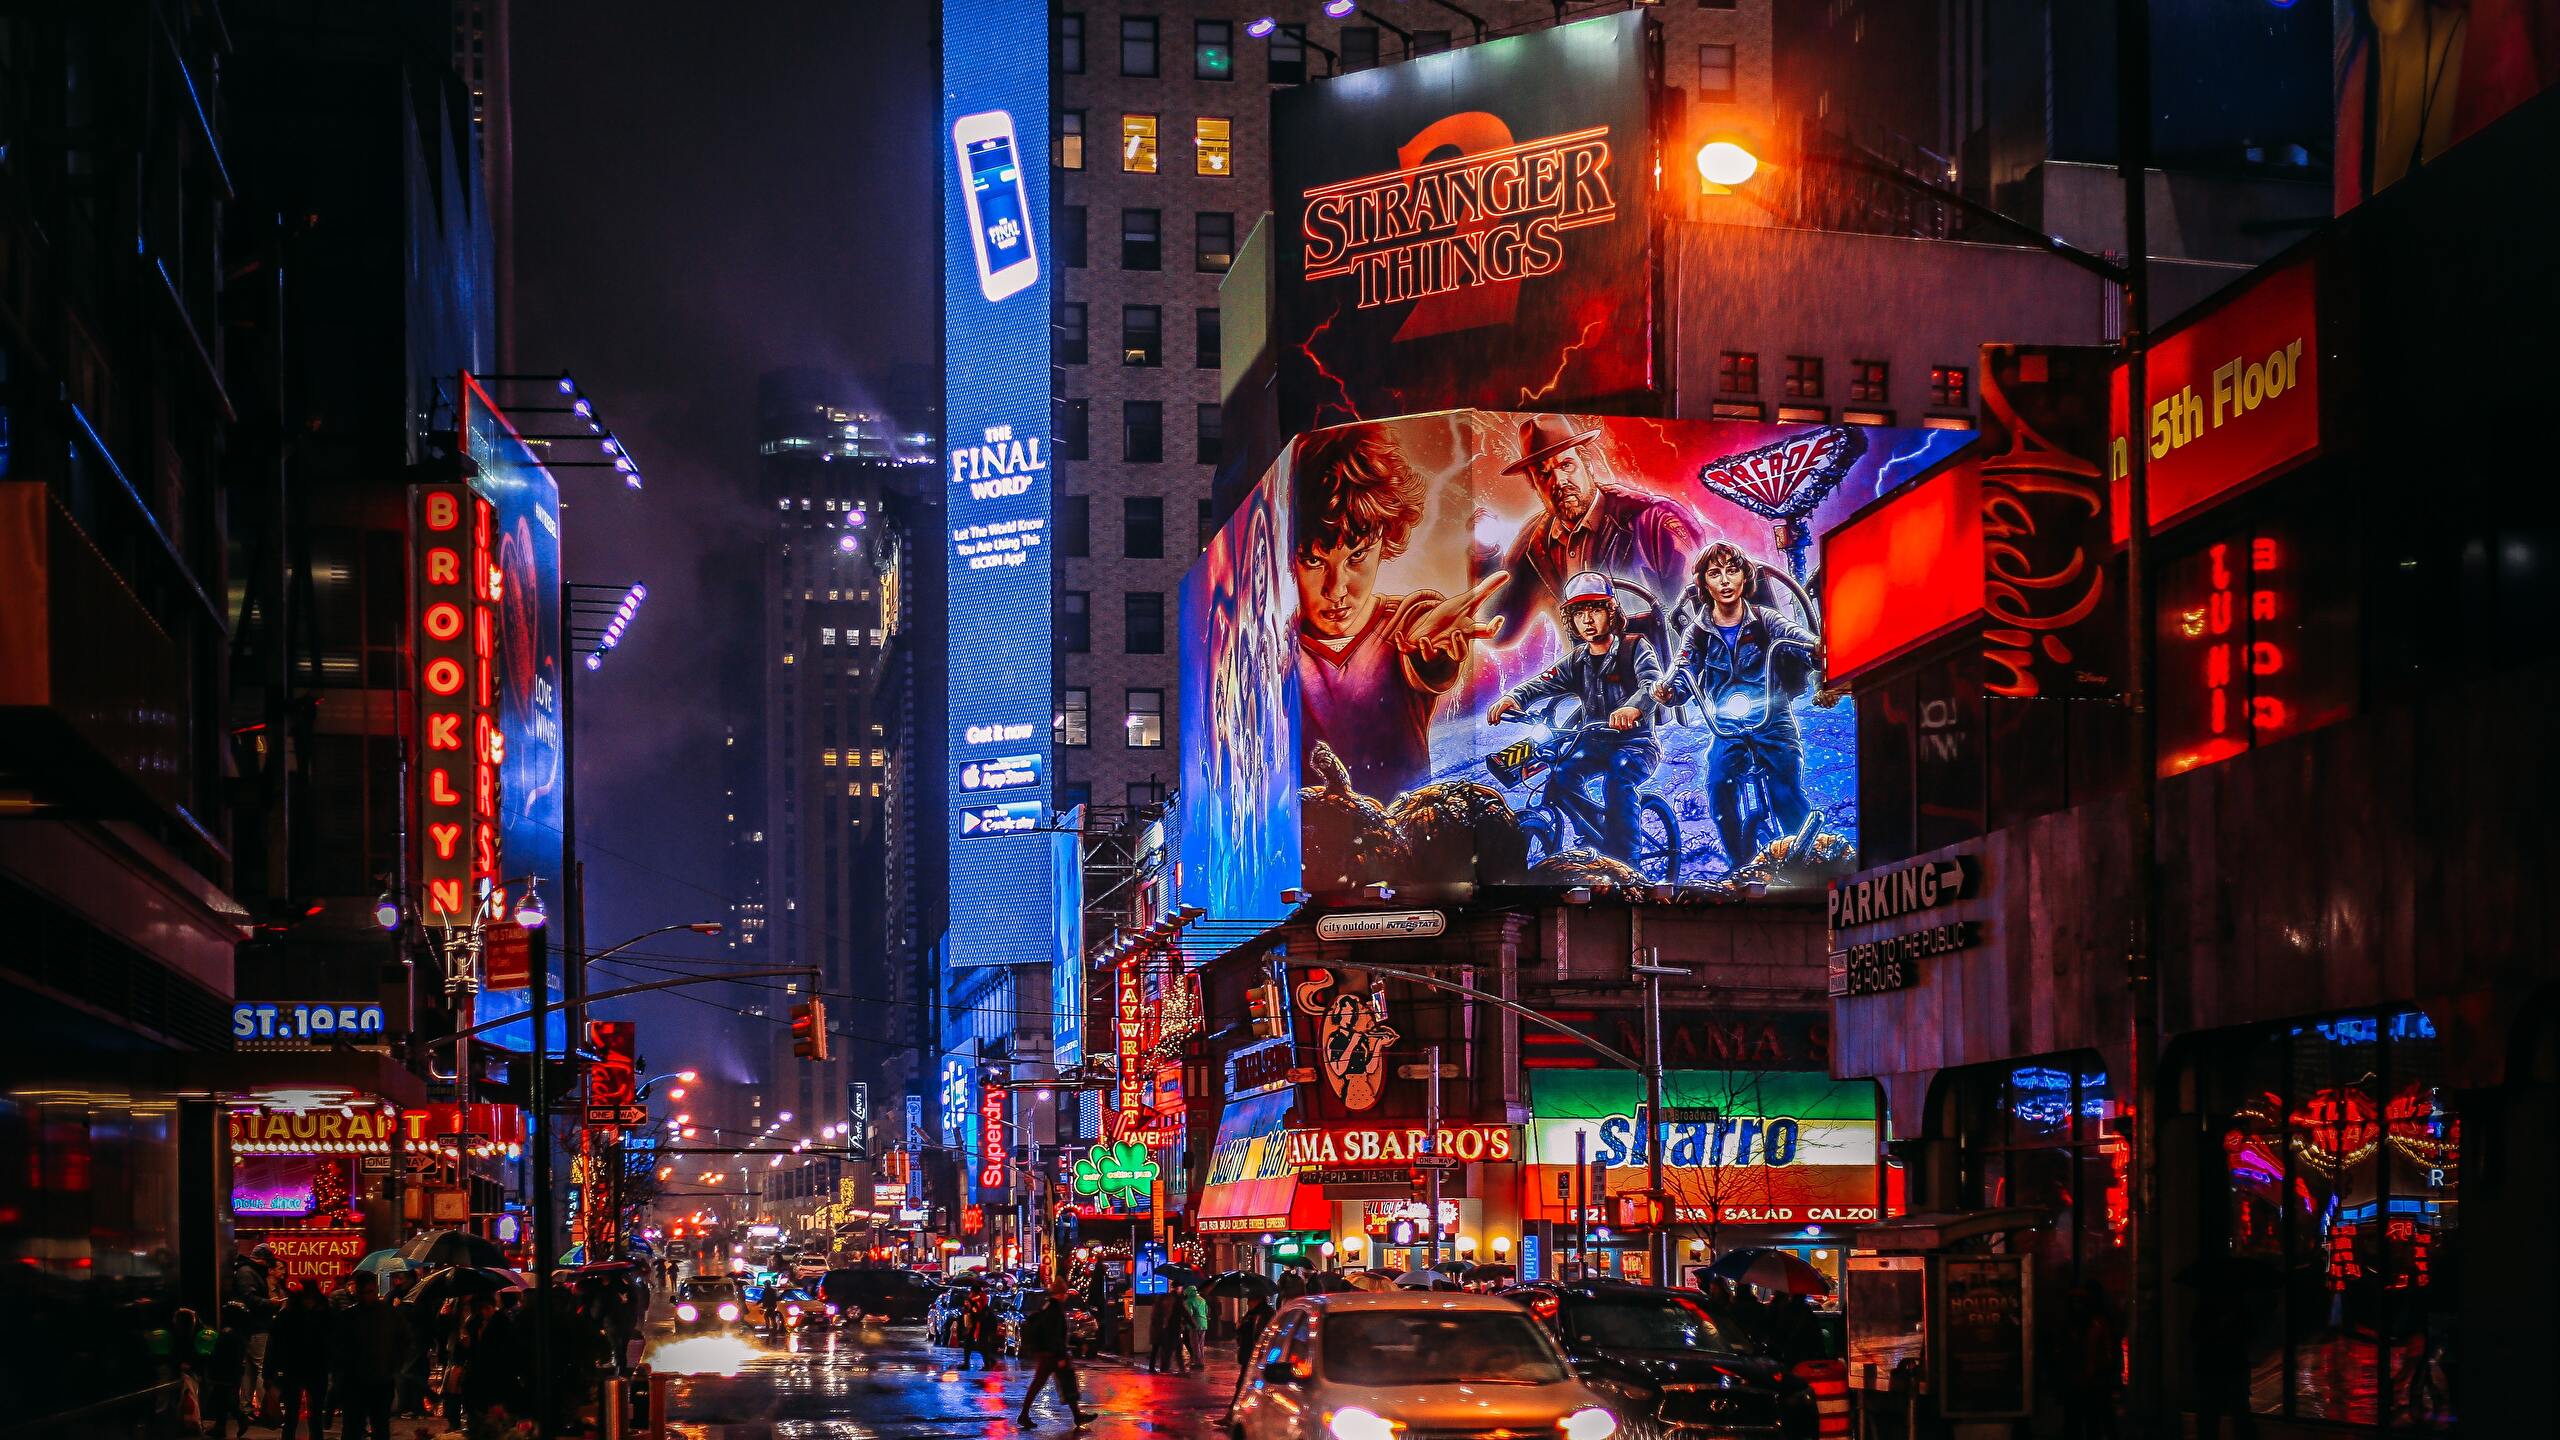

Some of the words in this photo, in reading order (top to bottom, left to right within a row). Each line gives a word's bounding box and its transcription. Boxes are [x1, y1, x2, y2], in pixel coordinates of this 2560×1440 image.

[1304, 141, 1616, 270] STRANGER
[1392, 111, 1524, 343] 2
[1350, 217, 1563, 309] THINGS
[2147, 384, 2204, 463] 5th
[2212, 336, 2303, 428] Floor
[985, 425, 1012, 443] THE
[952, 438, 1046, 482] FINAL
[1707, 434, 1844, 489] ARCADE
[970, 525, 988, 539] The
[988, 521, 1017, 536] World
[1018, 518, 1044, 532] Know
[957, 544, 976, 556] You
[976, 541, 993, 554] Are
[994, 537, 1020, 551] Using
[1021, 534, 1041, 546] This
[424, 490, 464, 915] BROOKLYN
[535, 674, 552, 713] LOVE
[966, 726, 993, 744] Get
[1004, 725, 1033, 740] now
[1828, 863, 1937, 930] PARKING
[1323, 921, 1341, 934] city
[1342, 920, 1381, 932] outdoor
[1850, 939, 1879, 968] OPEN
[1880, 937, 1895, 963] TO
[1898, 932, 1919, 959] THE
[1922, 922, 1965, 954] PUBLIC
[1850, 971, 1862, 995] 24
[1864, 963, 1901, 991] HOURS
[591, 1111, 610, 1119] ONE
[619, 1111, 639, 1119] WAY
[1674, 1109, 1717, 1122] Broadway
[440, 1137, 457, 1145] ONE
[982, 1086, 1006, 1188] Superdry
[1123, 1131, 1174, 1145] TAVE
[1287, 1132, 1339, 1164] AMA
[1343, 1128, 1510, 1161] SBARRO'S
[367, 1157, 390, 1167] ONE
[1570, 1209, 1607, 1221] PIZ
[1724, 1208, 1792, 1221] SALAD
[269, 1241, 359, 1256] BREAKFAST
[289, 1261, 340, 1275] LUNCH
